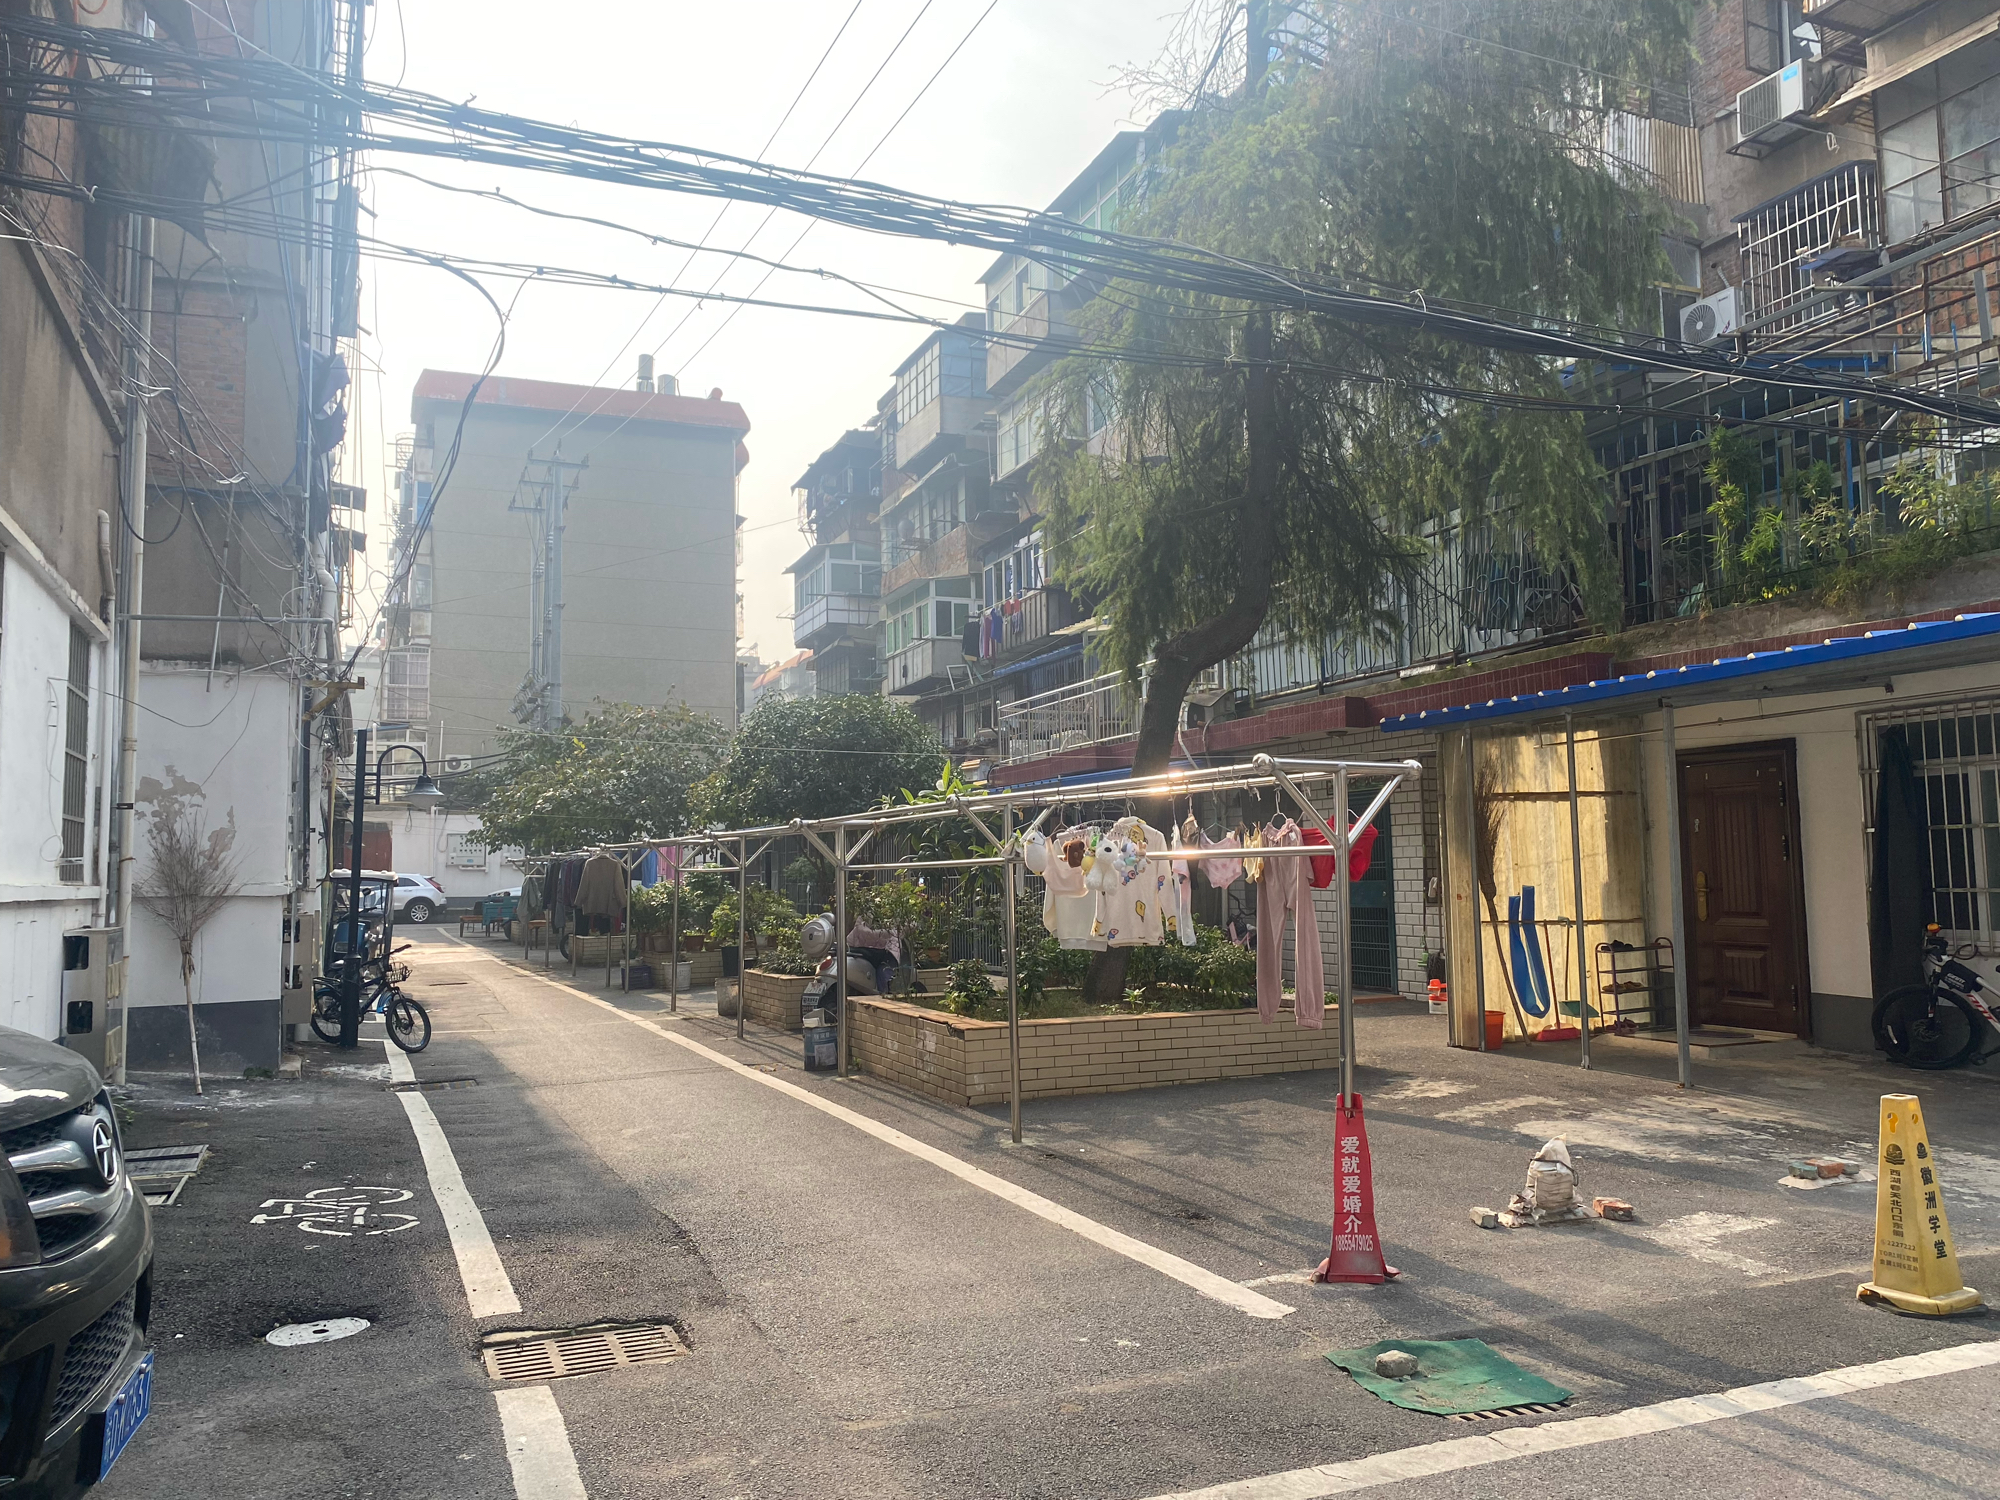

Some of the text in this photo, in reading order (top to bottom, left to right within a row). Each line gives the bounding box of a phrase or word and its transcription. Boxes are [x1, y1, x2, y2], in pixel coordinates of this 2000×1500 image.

[1340, 1136, 1362, 1233] 爱就爱婚介
